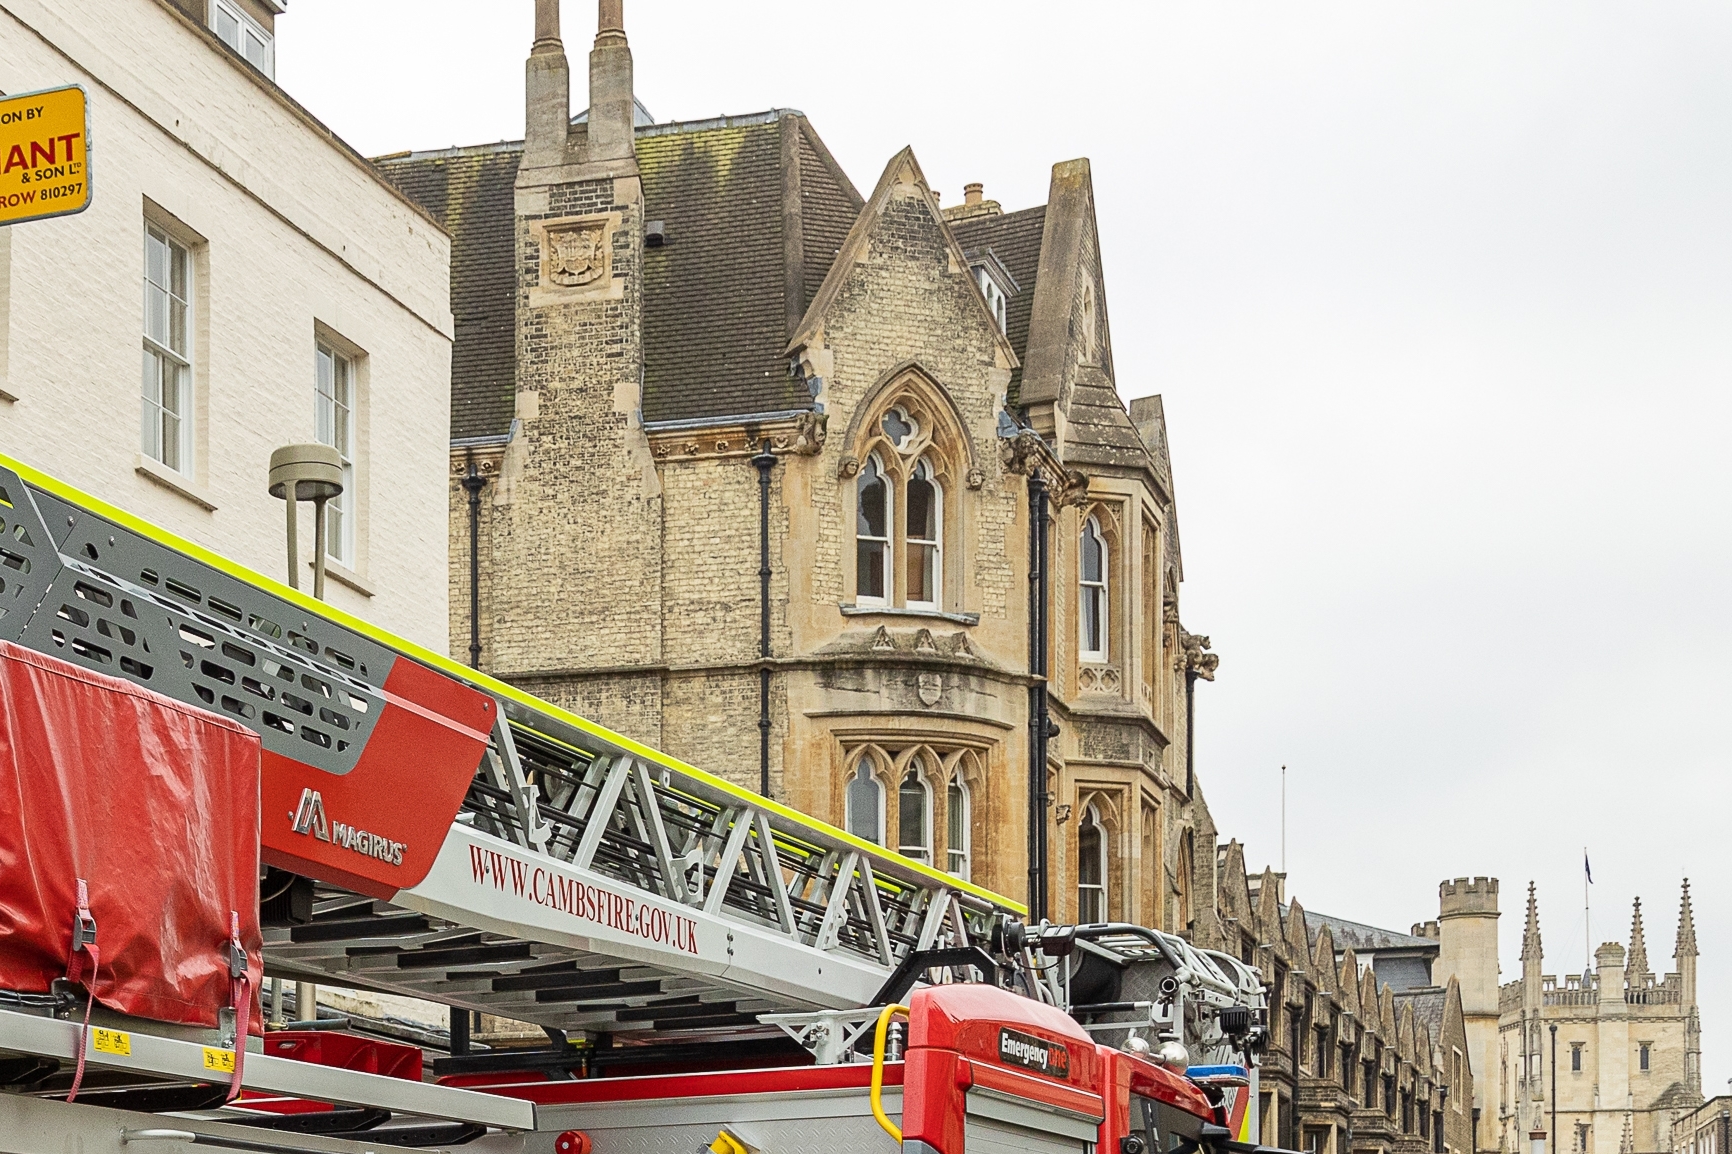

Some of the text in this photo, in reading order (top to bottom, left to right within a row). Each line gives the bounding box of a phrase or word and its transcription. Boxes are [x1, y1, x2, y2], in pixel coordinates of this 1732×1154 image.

[26, 106, 44, 120] BY
[21, 172, 31, 184] &
[35, 166, 65, 181] SON
[40, 183, 83, 201] 810297
[332, 820, 403, 866] MAGIRUS
[468, 844, 698, 955] WWW.CAMBSFIRE.GOV.UK
